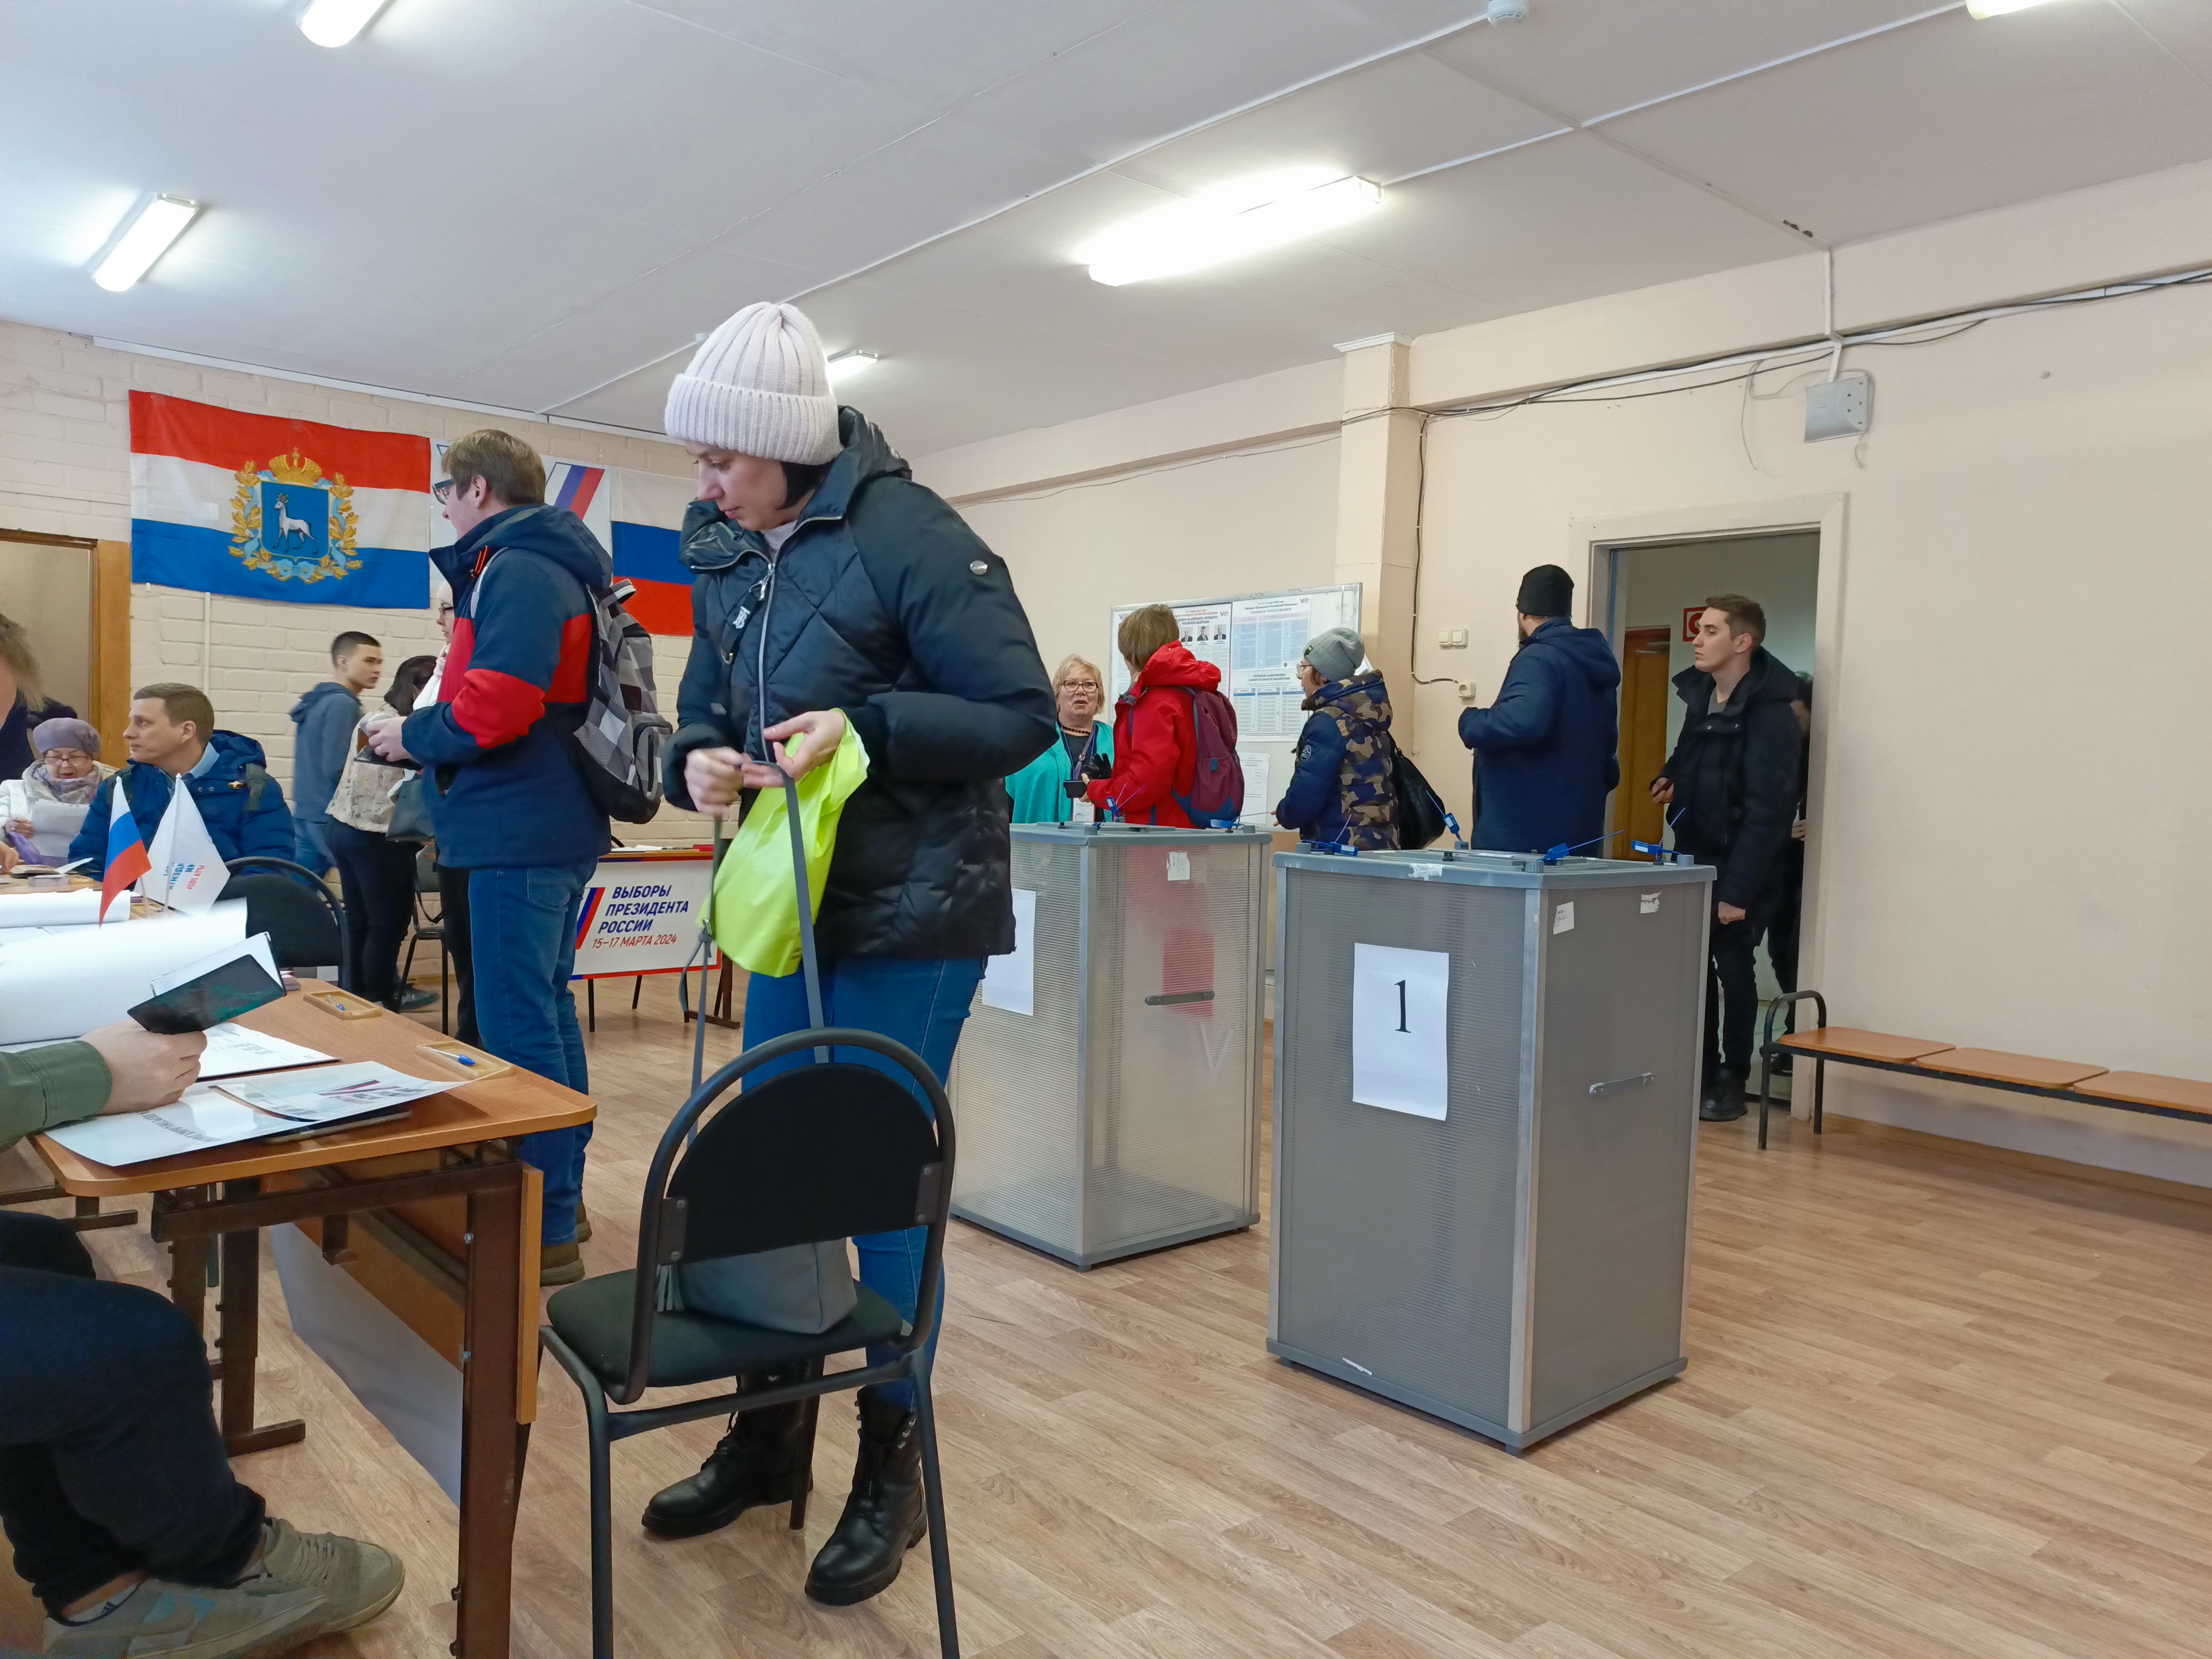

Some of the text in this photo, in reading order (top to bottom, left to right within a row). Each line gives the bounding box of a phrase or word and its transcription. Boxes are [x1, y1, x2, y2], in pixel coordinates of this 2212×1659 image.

[612, 885, 672, 899] ВЫБОРЫ
[605, 901, 689, 916] ПРЕЗИДЕНТА
[598, 919, 653, 934] РОССИИ
[620, 935, 653, 948] МАРТА
[653, 934, 677, 945] 2024
[1394, 980, 1411, 1034] 1
